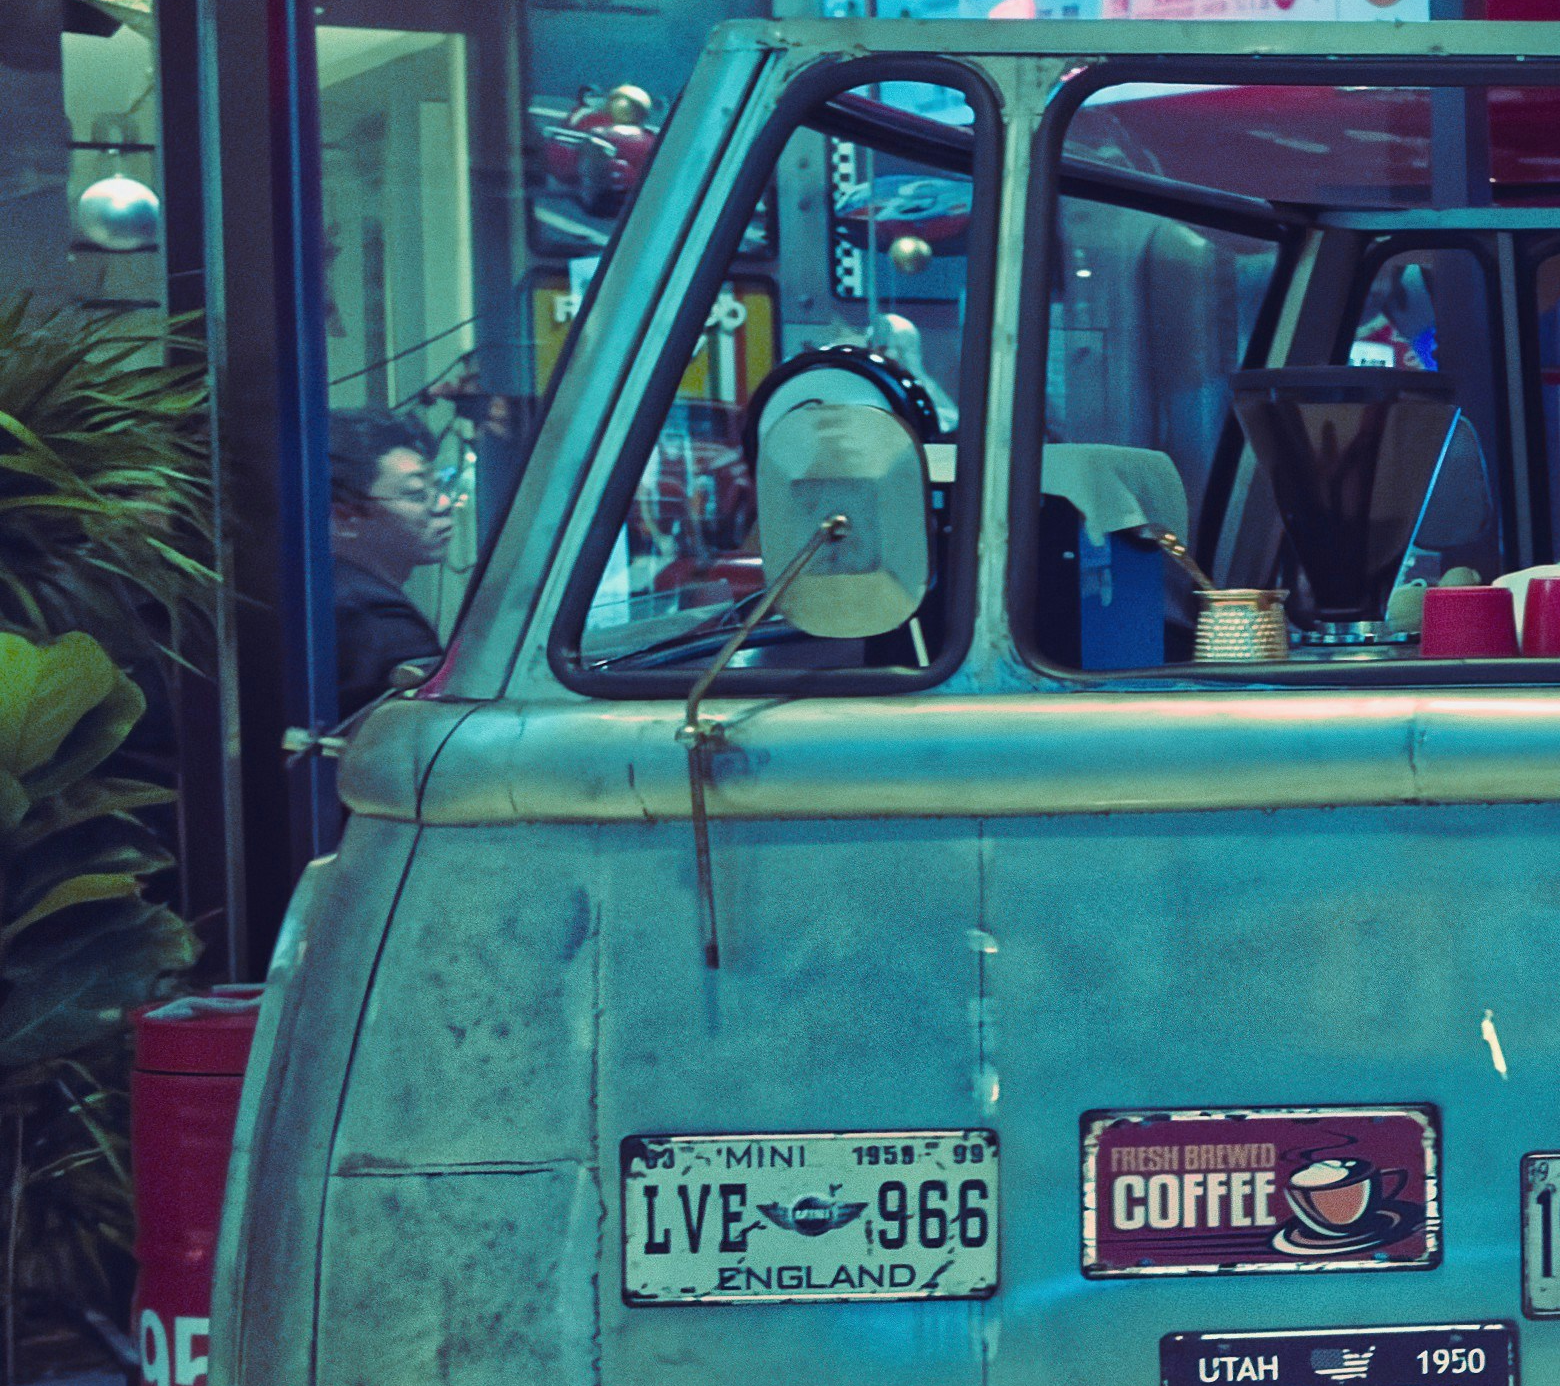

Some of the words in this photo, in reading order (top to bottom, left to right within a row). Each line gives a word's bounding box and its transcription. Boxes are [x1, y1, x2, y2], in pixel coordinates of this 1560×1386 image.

[952, 1143, 985, 1165] 99
[1110, 1145, 1180, 1172] FRESH
[1184, 1142, 1277, 1171] BREWED
[643, 1182, 747, 1255] LVE
[877, 1178, 989, 1250] 966
[1112, 1170, 1277, 1231] COFFEE
[717, 1263, 917, 1291] ENGLAND
[1198, 1355, 1279, 1383] UTAH
[1416, 1347, 1487, 1375] 1950
